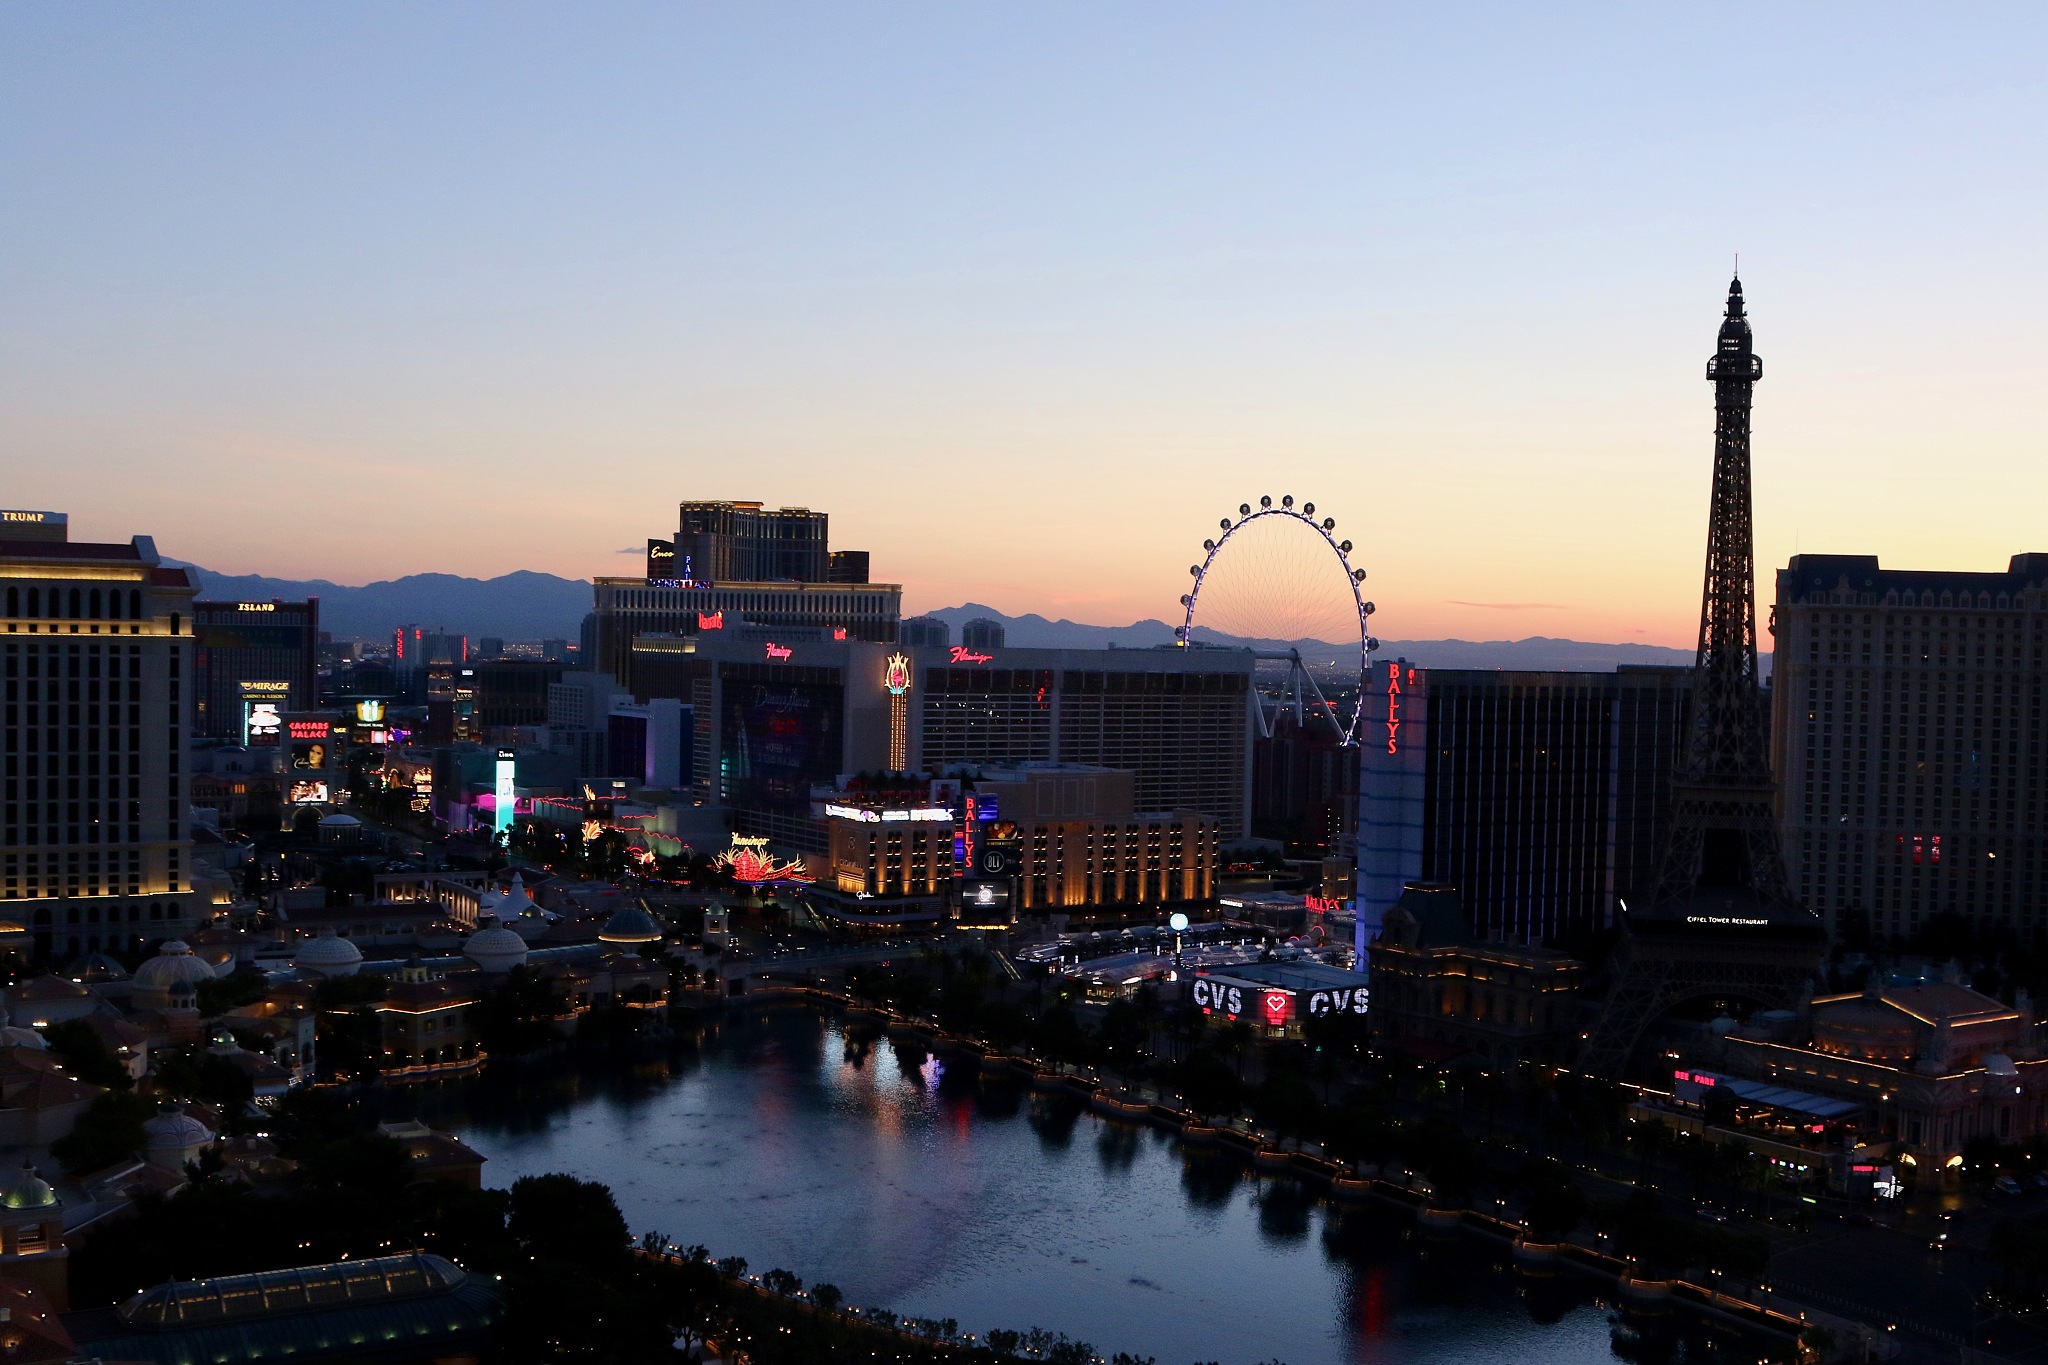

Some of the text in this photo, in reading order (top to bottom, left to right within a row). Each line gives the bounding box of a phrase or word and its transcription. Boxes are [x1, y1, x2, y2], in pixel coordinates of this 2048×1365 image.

[2, 512, 45, 522] TRUMP
[238, 603, 275, 612] ISLAND
[766, 642, 793, 661] Flamingo
[950, 646, 993, 664] Flamingo
[251, 682, 290, 692] MIRAGE
[289, 722, 330, 730] CAESARS
[291, 731, 328, 739] PALACE
[731, 832, 770, 847] Flamingo
[988, 855, 1000, 868] BLT
[1193, 979, 1242, 1014] CVS
[1310, 988, 1370, 1018] CVS
[1694, 1074, 1715, 1087] PARK
